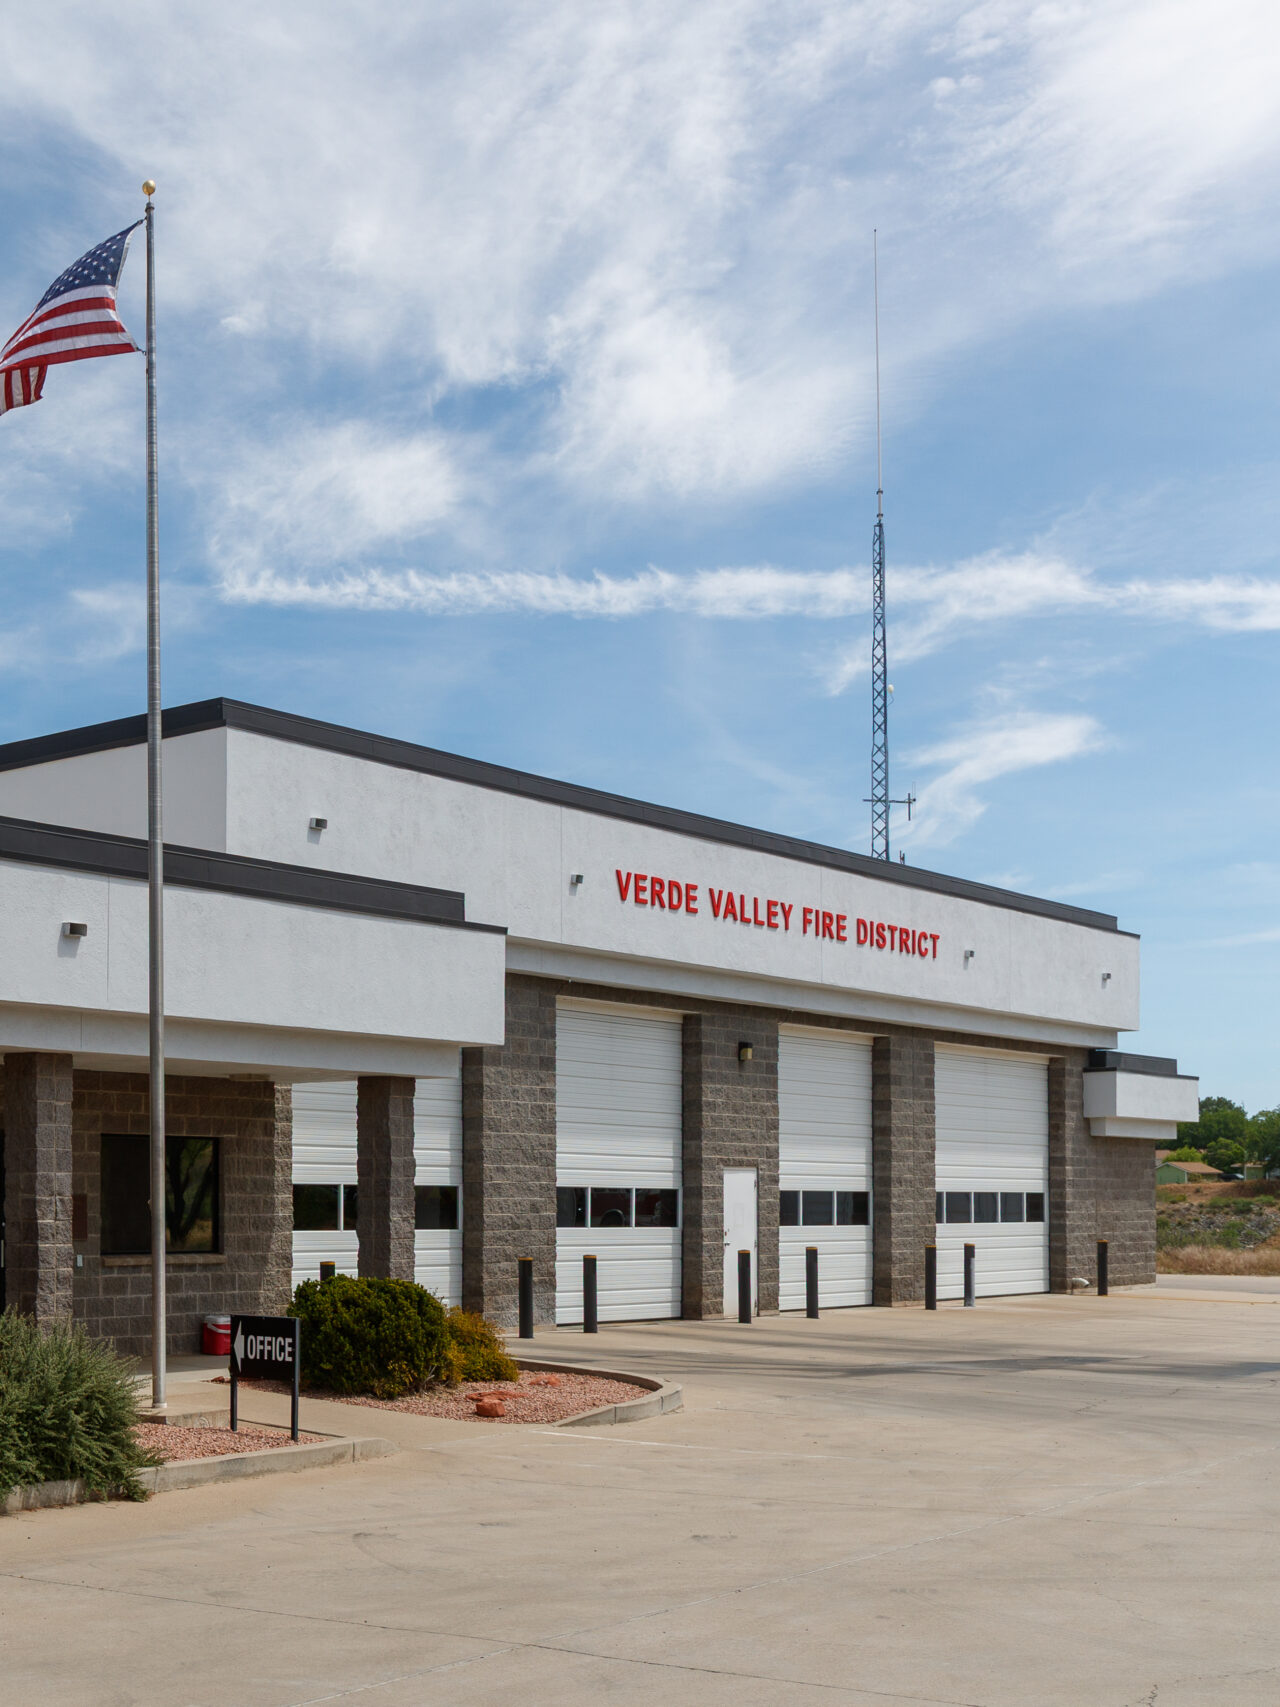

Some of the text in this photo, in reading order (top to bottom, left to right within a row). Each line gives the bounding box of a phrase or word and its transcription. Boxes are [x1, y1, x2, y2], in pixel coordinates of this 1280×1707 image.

[615, 869, 940, 959] VERDE VALLEY FIRE DISTRICT
[247, 1334, 293, 1362] OFFICE
